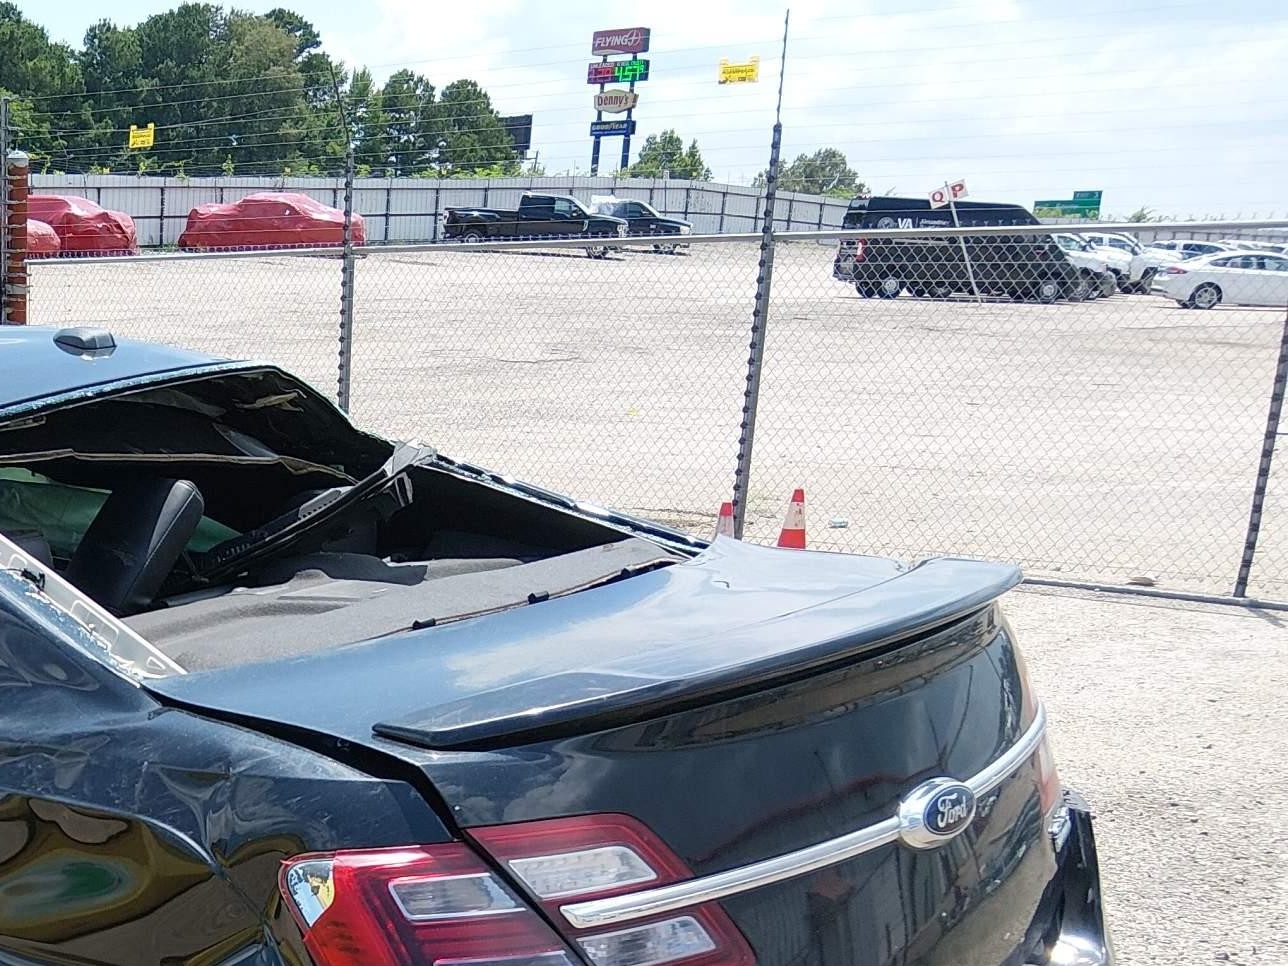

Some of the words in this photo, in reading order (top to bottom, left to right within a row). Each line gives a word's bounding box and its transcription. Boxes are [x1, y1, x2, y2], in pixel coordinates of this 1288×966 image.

[595, 34, 628, 47] FLYING
[597, 93, 629, 107] Denny's
[932, 191, 945, 203] Q
[951, 183, 964, 198] P
[897, 218, 913, 228] VA
[937, 792, 969, 828] Ford
